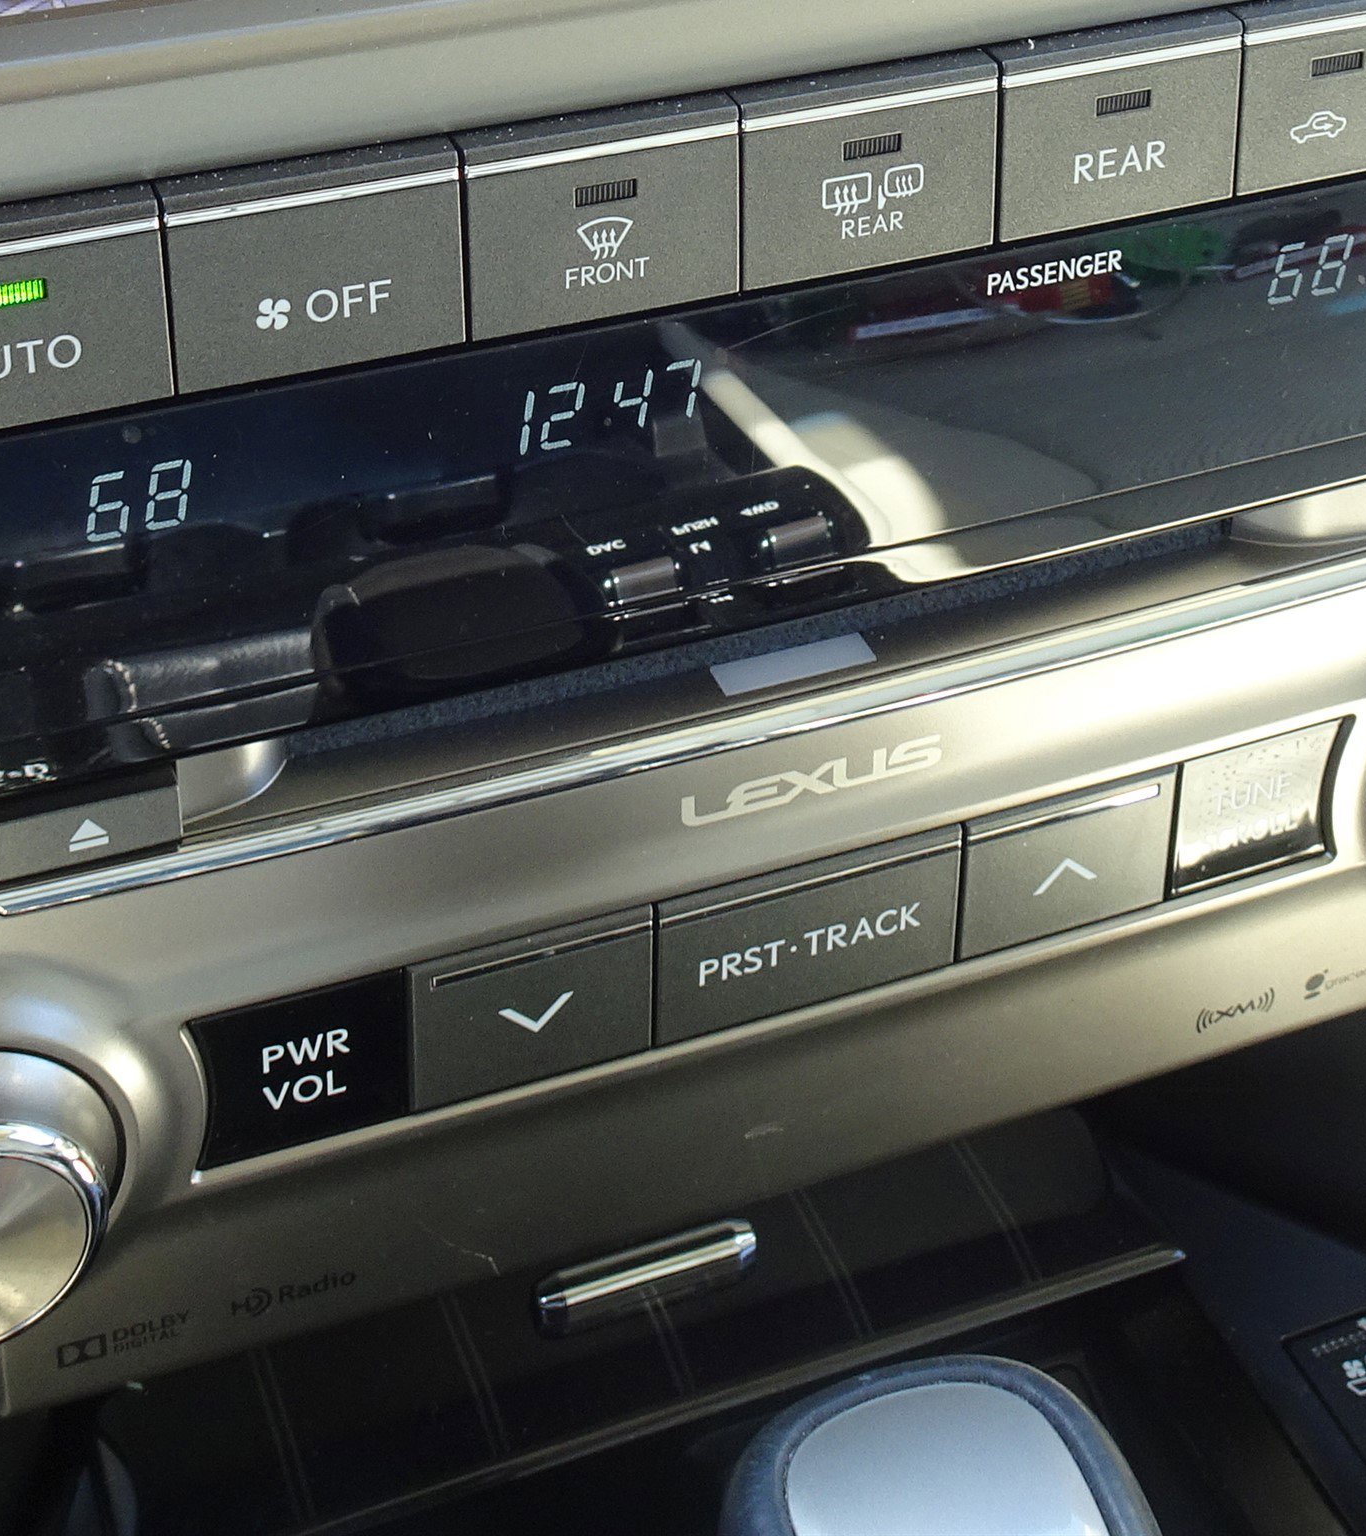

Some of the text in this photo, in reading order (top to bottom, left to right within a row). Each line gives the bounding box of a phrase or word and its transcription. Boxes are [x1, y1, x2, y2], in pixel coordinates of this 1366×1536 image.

[1073, 140, 1166, 185] REAR
[841, 210, 904, 240] REAR
[565, 256, 651, 289] FRONT
[986, 249, 1123, 297] PASSENGER
[1267, 233, 1356, 305] 68
[305, 279, 393, 324] OFF
[86, 458, 193, 543] 68
[681, 734, 943, 828] LEXUS
[262, 1028, 351, 1074] PWR
[263, 1069, 348, 1111] VOL
[278, 1270, 357, 1304] Radio
[112, 1309, 190, 1341] DOLBY
